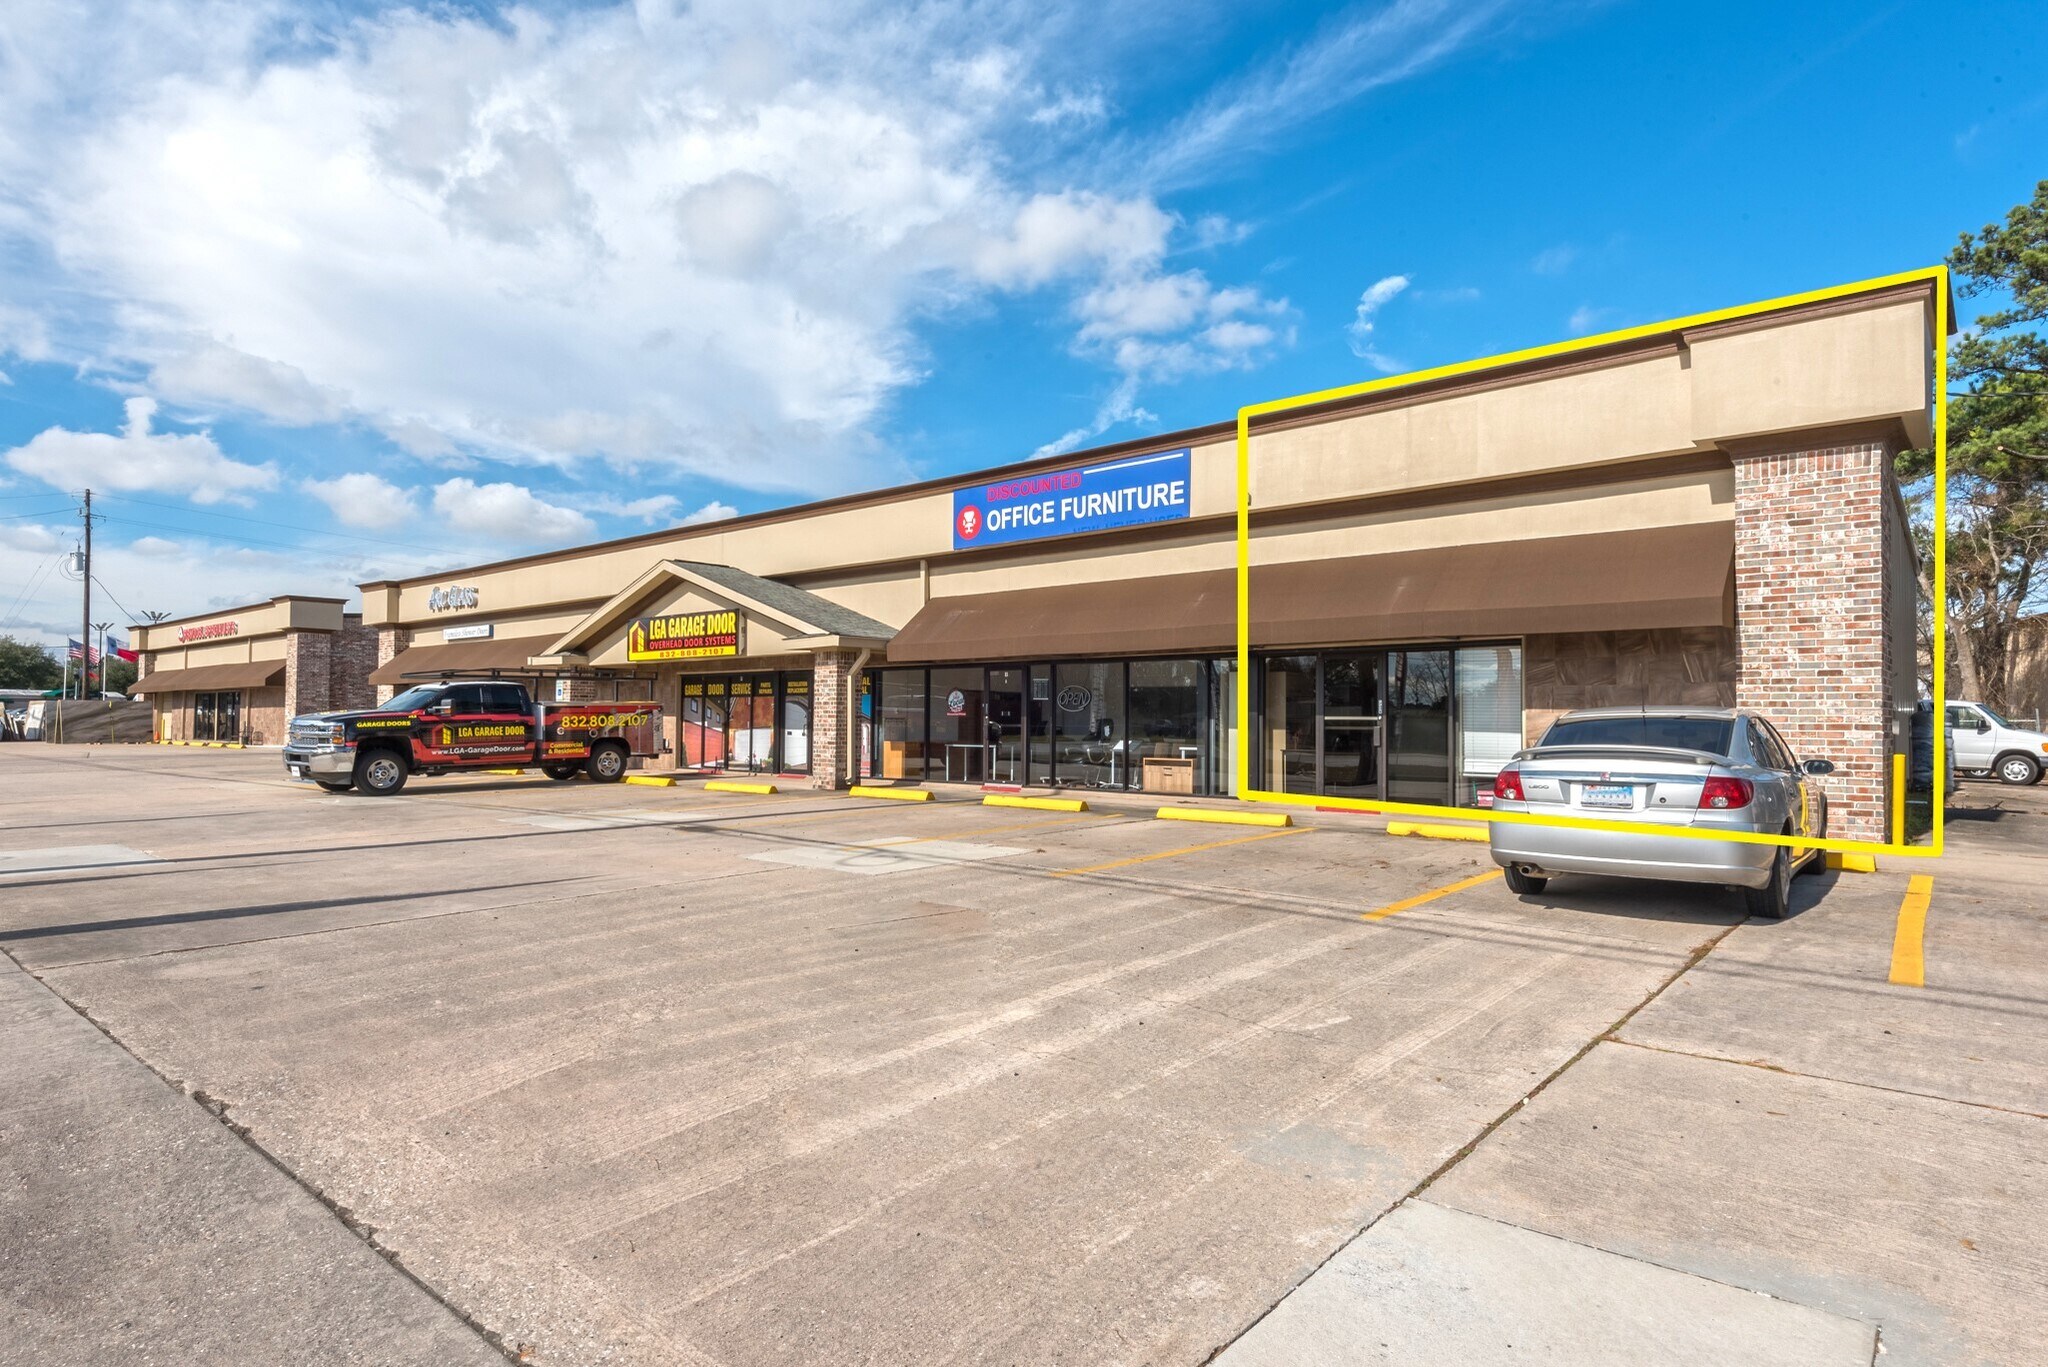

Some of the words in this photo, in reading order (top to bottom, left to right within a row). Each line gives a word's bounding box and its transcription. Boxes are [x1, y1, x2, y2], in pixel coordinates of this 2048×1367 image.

[987, 471, 1082, 502] DISCOUNTED
[986, 500, 1055, 532] OFFICE
[1061, 480, 1185, 521] FURNITURE
[649, 619, 667, 640] LGA
[668, 615, 705, 638] GARAGE
[707, 612, 737, 635] DOOR
[649, 639, 683, 650] OVERHEAD
[684, 638, 703, 648] DOOR
[705, 635, 736, 646] SYSTEMS
[659, 648, 725, 658] 832-808-2107
[685, 684, 703, 696] GARAGE
[707, 684, 725, 695] DOOR
[731, 683, 752, 695] SERVICE
[1059, 691, 1089, 706] OPEN
[561, 714, 648, 728] 832.808.2107
[458, 727, 473, 737] LGA
[474, 726, 504, 736] GARAGE
[505, 725, 525, 736] DOOR
[431, 745, 525, 755] www.LGA-GarageDoor.com
[549, 741, 584, 749] Commercial
